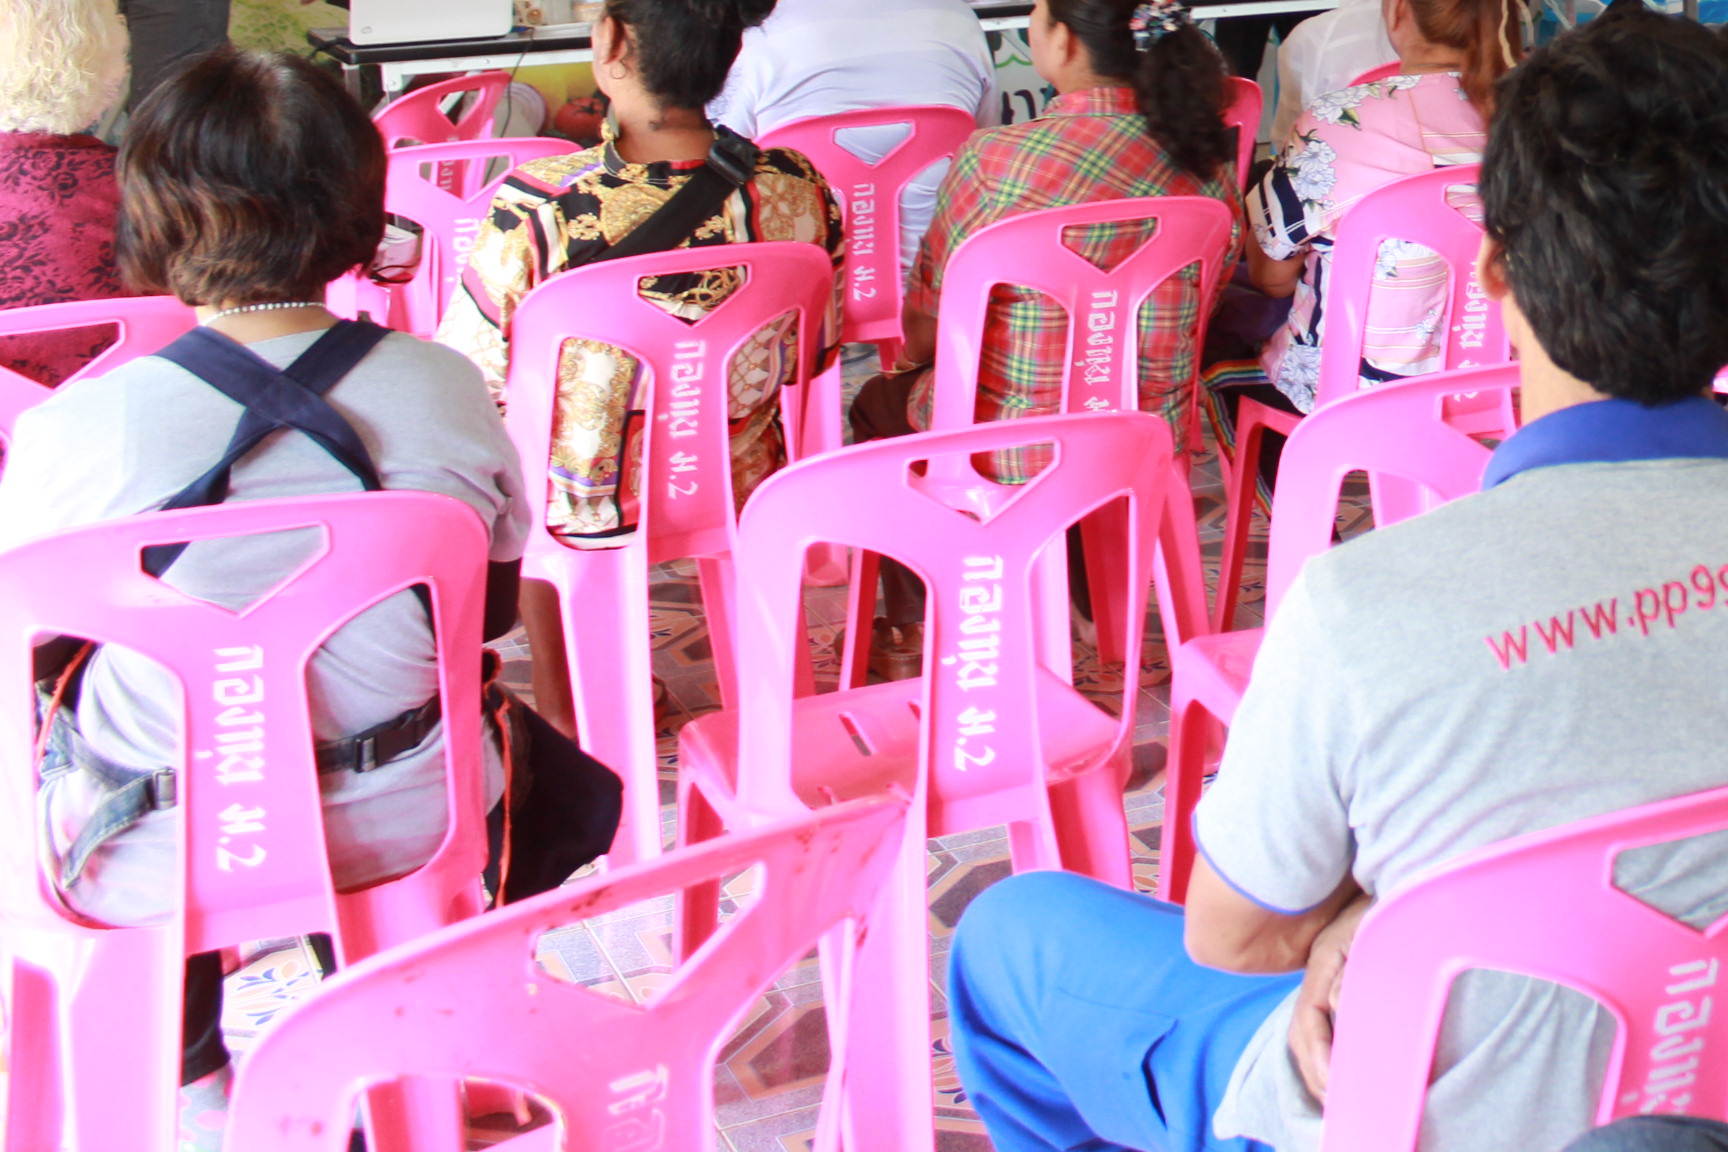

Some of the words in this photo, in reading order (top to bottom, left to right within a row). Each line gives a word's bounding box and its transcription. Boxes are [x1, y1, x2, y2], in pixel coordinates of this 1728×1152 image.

[852, 265, 877, 301] ม.2
[667, 450, 699, 500] ม.2
[954, 705, 997, 773] ม.2
[214, 802, 268, 873] ม.2
